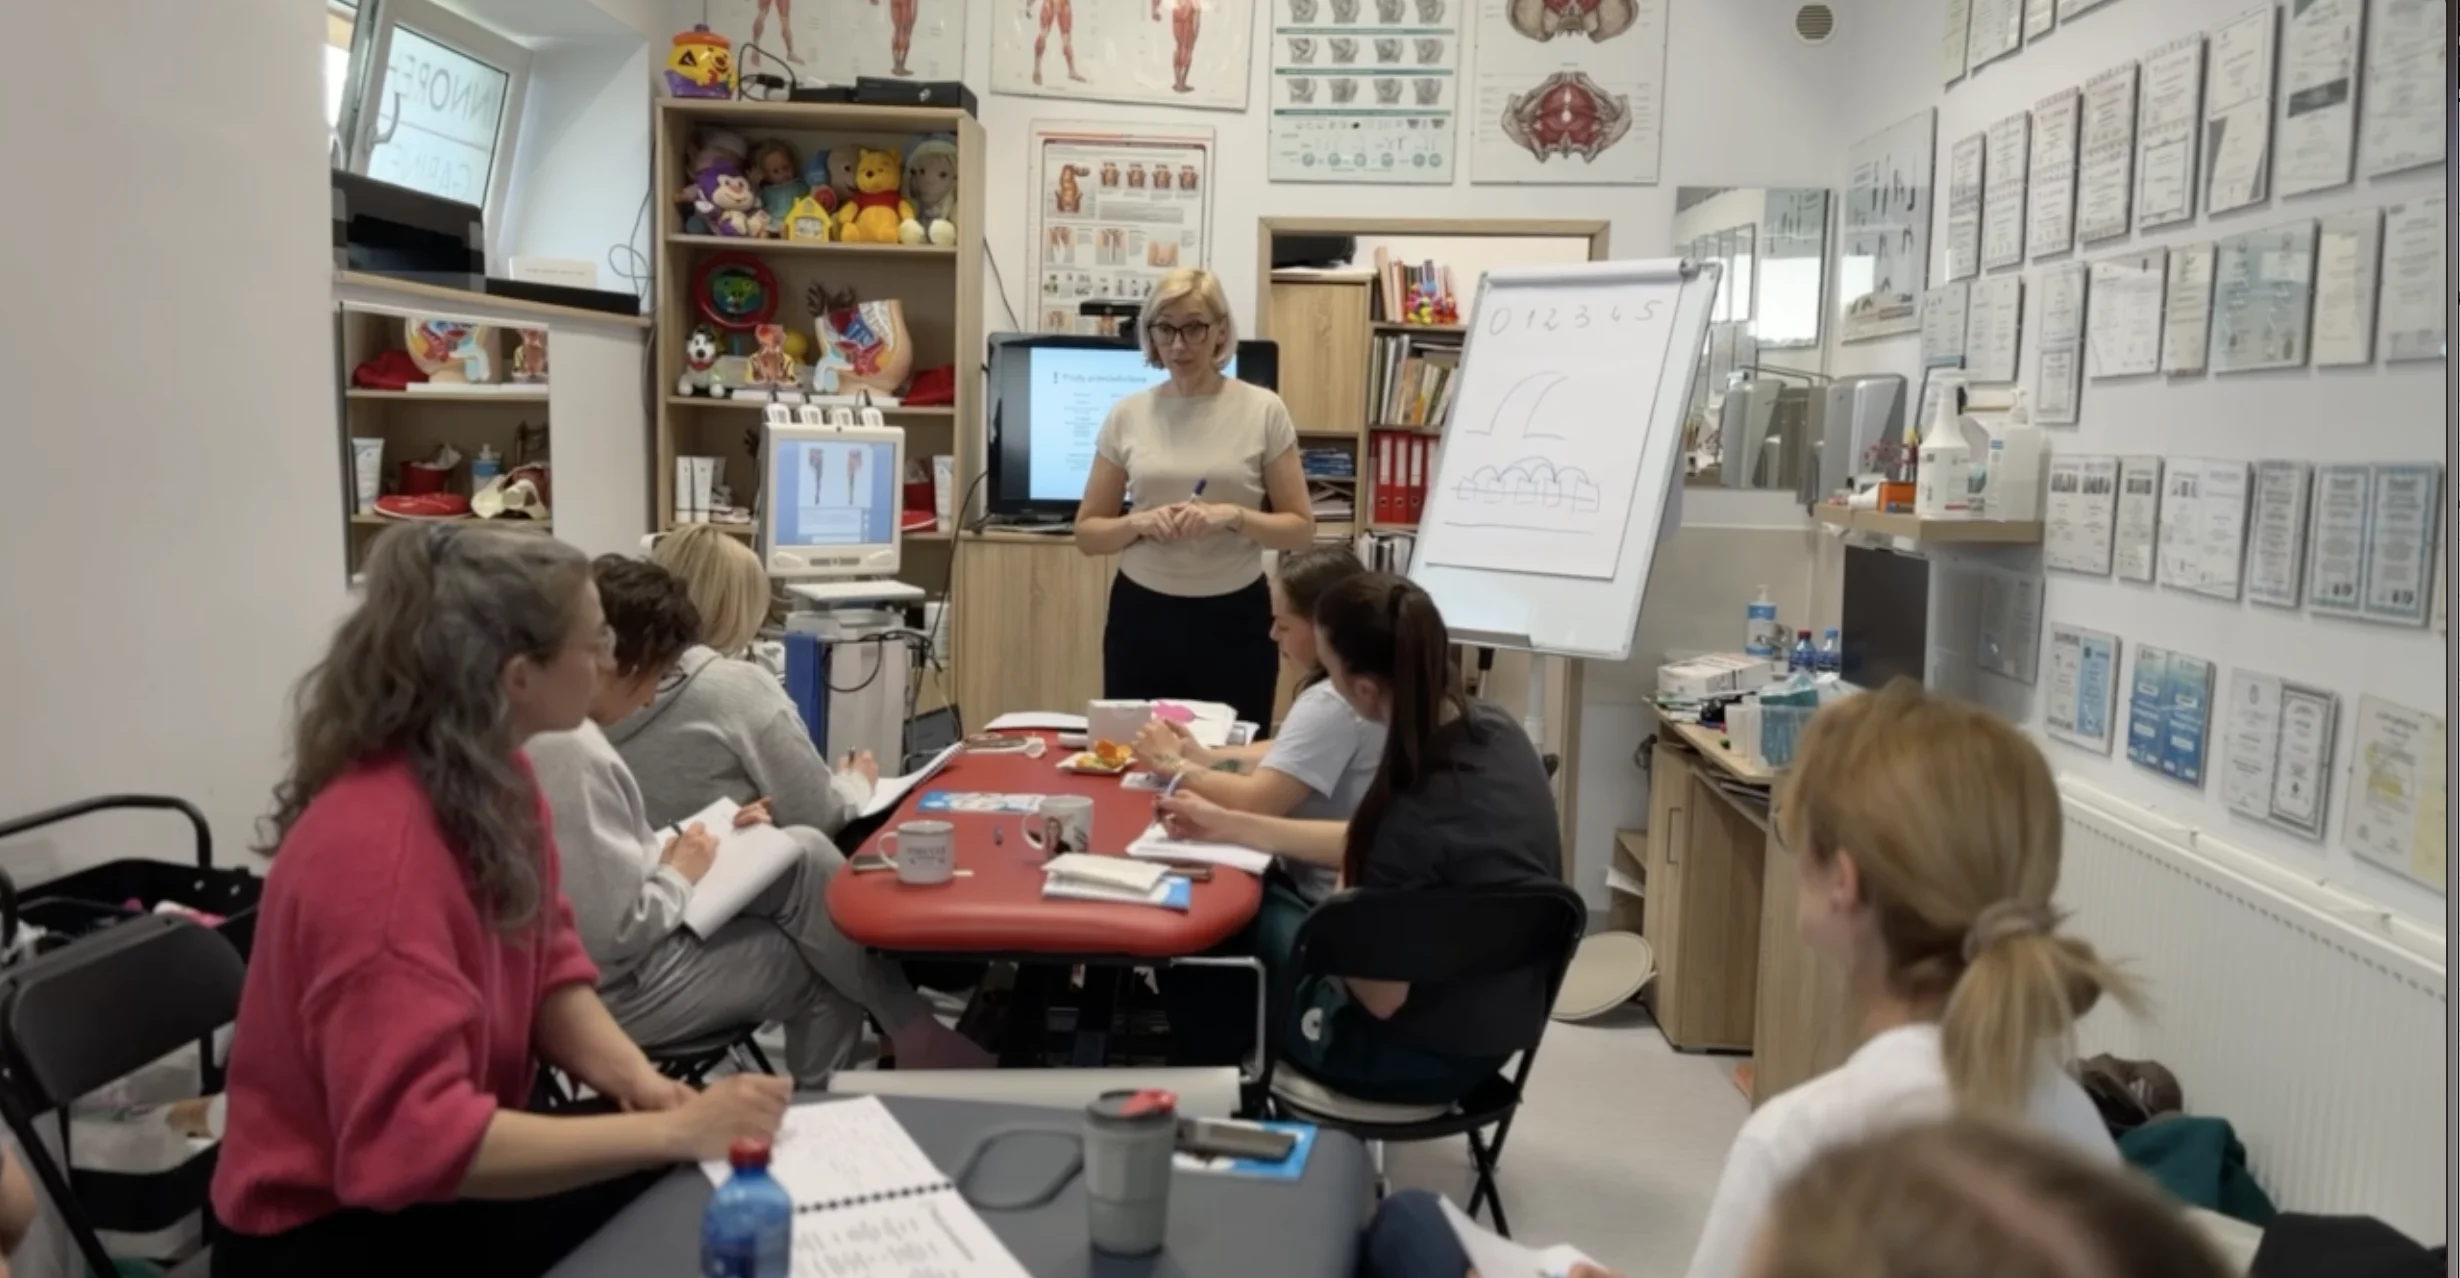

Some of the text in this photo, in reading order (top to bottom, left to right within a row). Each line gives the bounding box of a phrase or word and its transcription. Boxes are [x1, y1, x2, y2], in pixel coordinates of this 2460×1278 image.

[1489, 306, 1511, 336] 0
[1526, 309, 1536, 330] 1
[1542, 306, 1559, 331] 2
[1574, 304, 1591, 329] 3
[1634, 299, 1663, 322] 5
